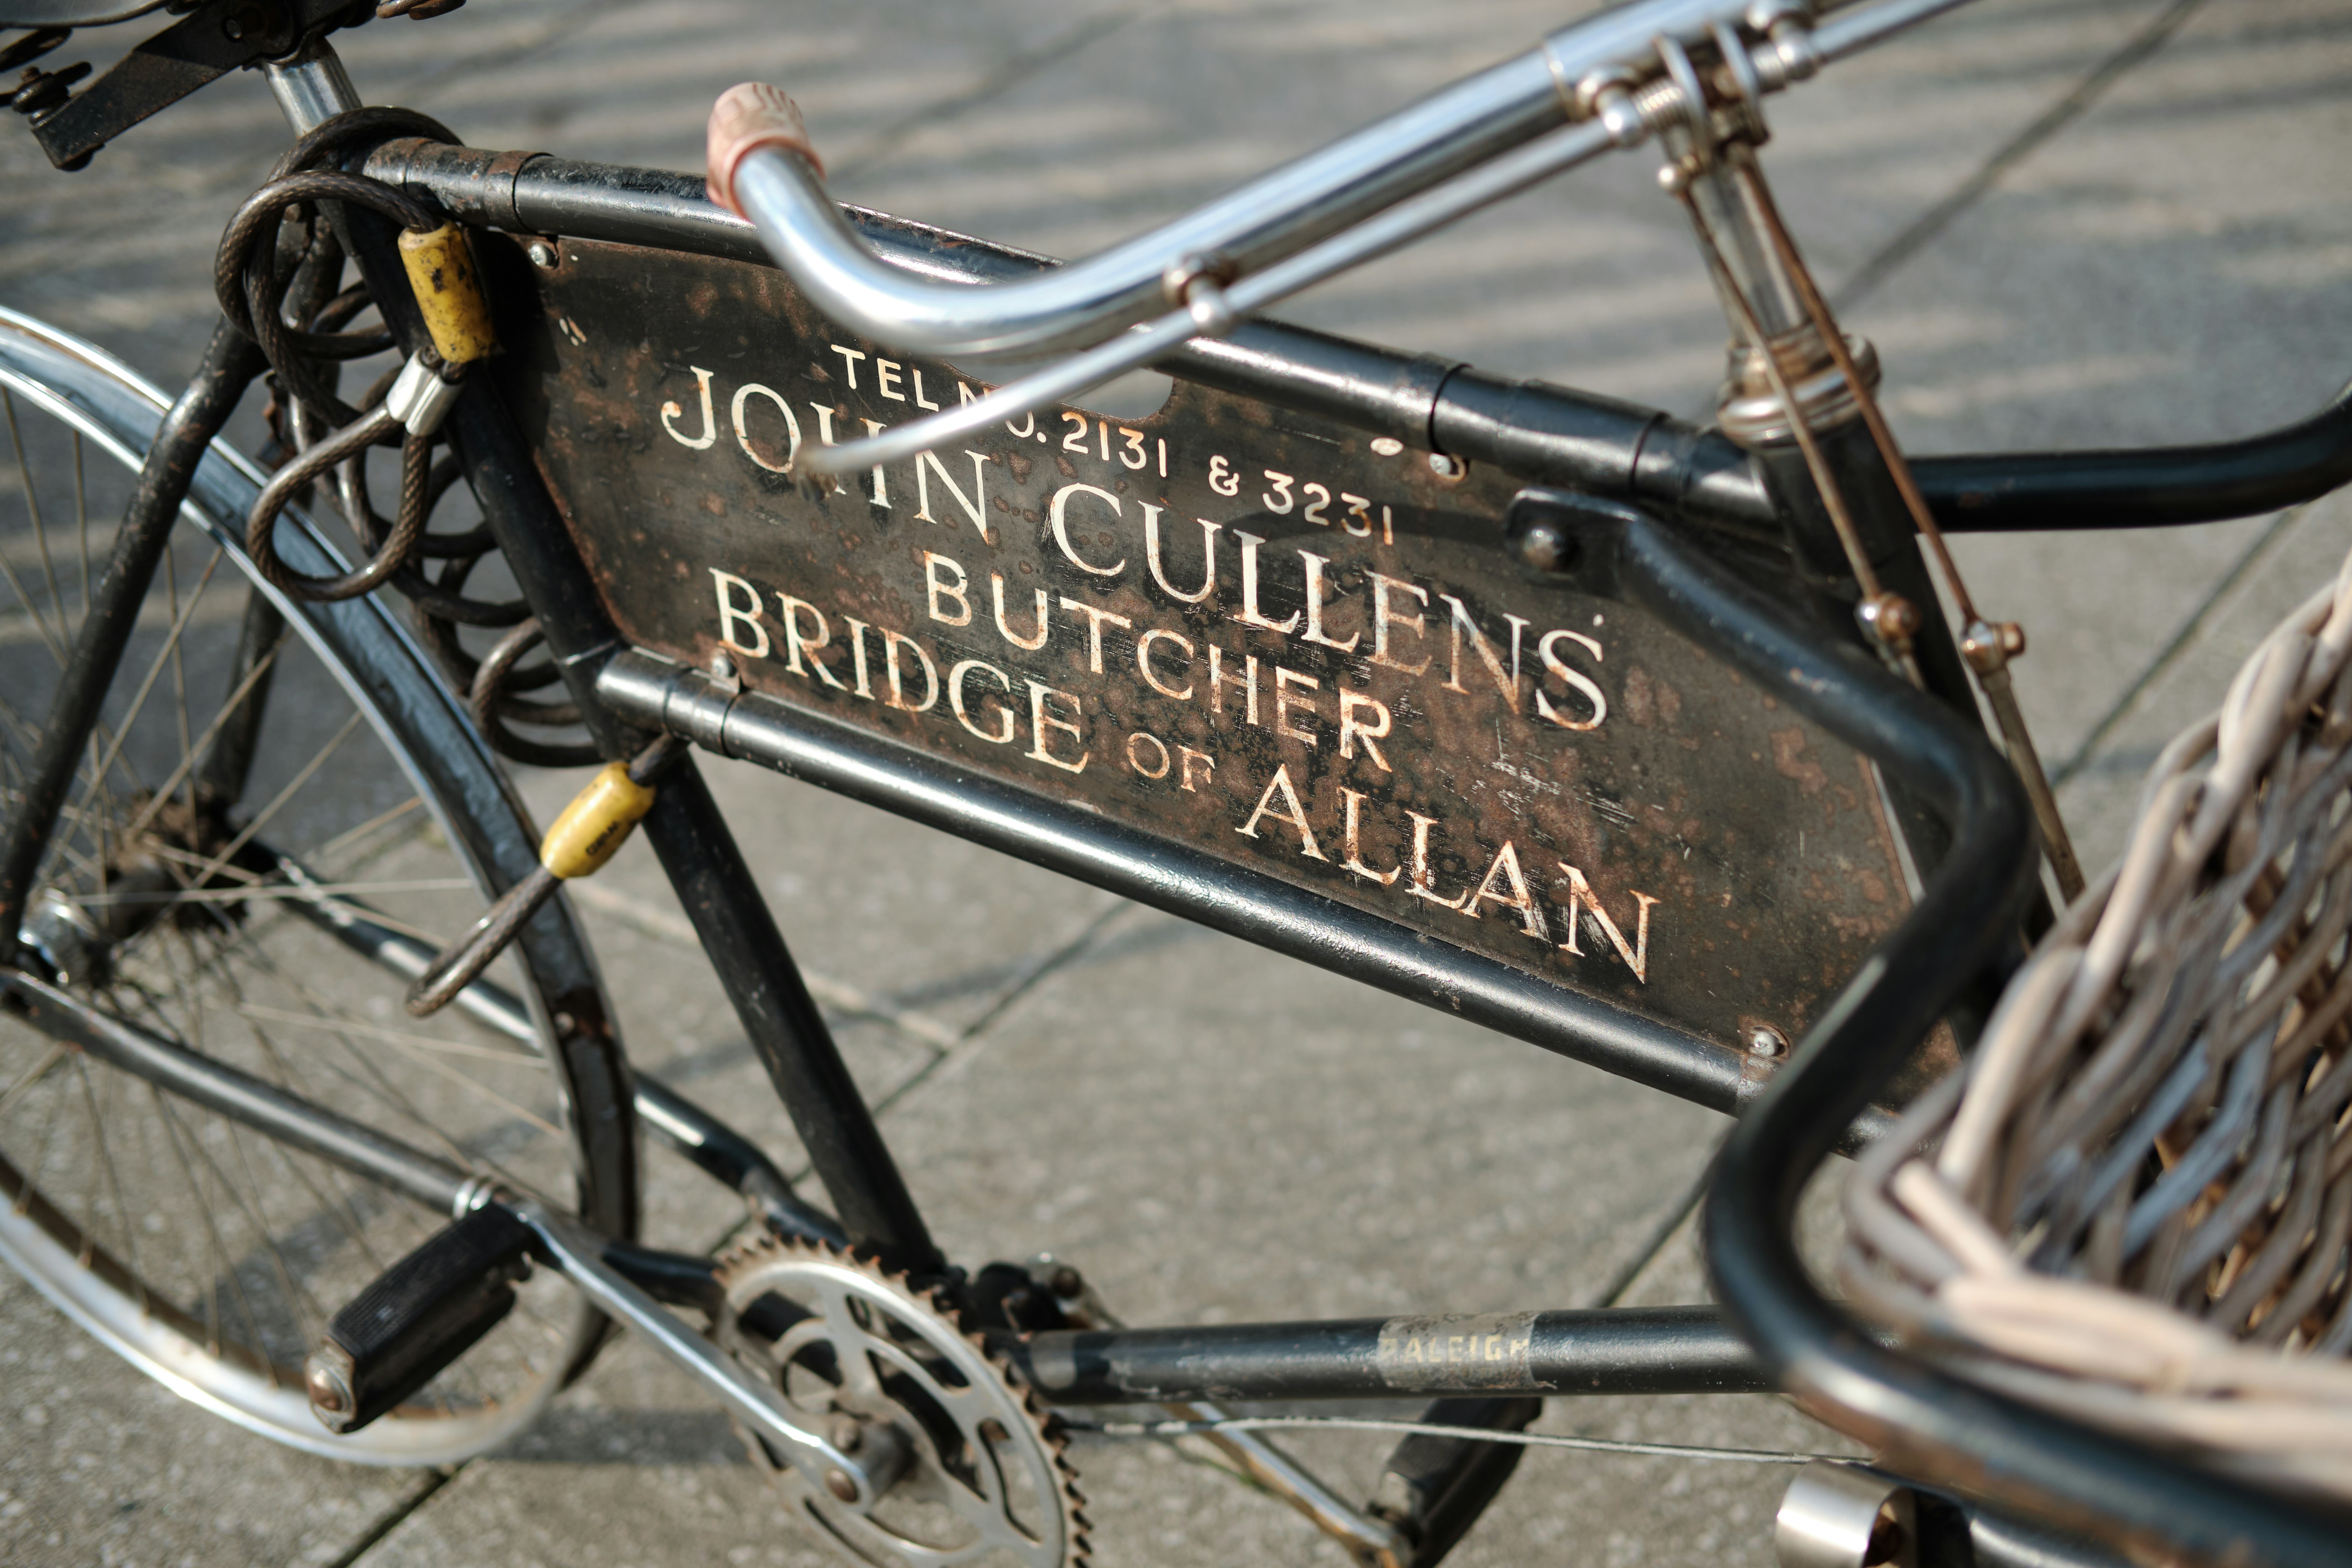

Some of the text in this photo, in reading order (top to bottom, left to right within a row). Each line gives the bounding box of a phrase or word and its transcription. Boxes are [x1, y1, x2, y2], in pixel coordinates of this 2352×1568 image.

[830, 344, 939, 412] TEL
[1062, 411, 1167, 477] 2131
[1209, 455, 1240, 496] &
[1262, 470, 1394, 546] 3231
[923, 550, 1392, 773] BUTCHER
[709, 567, 1661, 985] BRIDGE OF ALLAN
